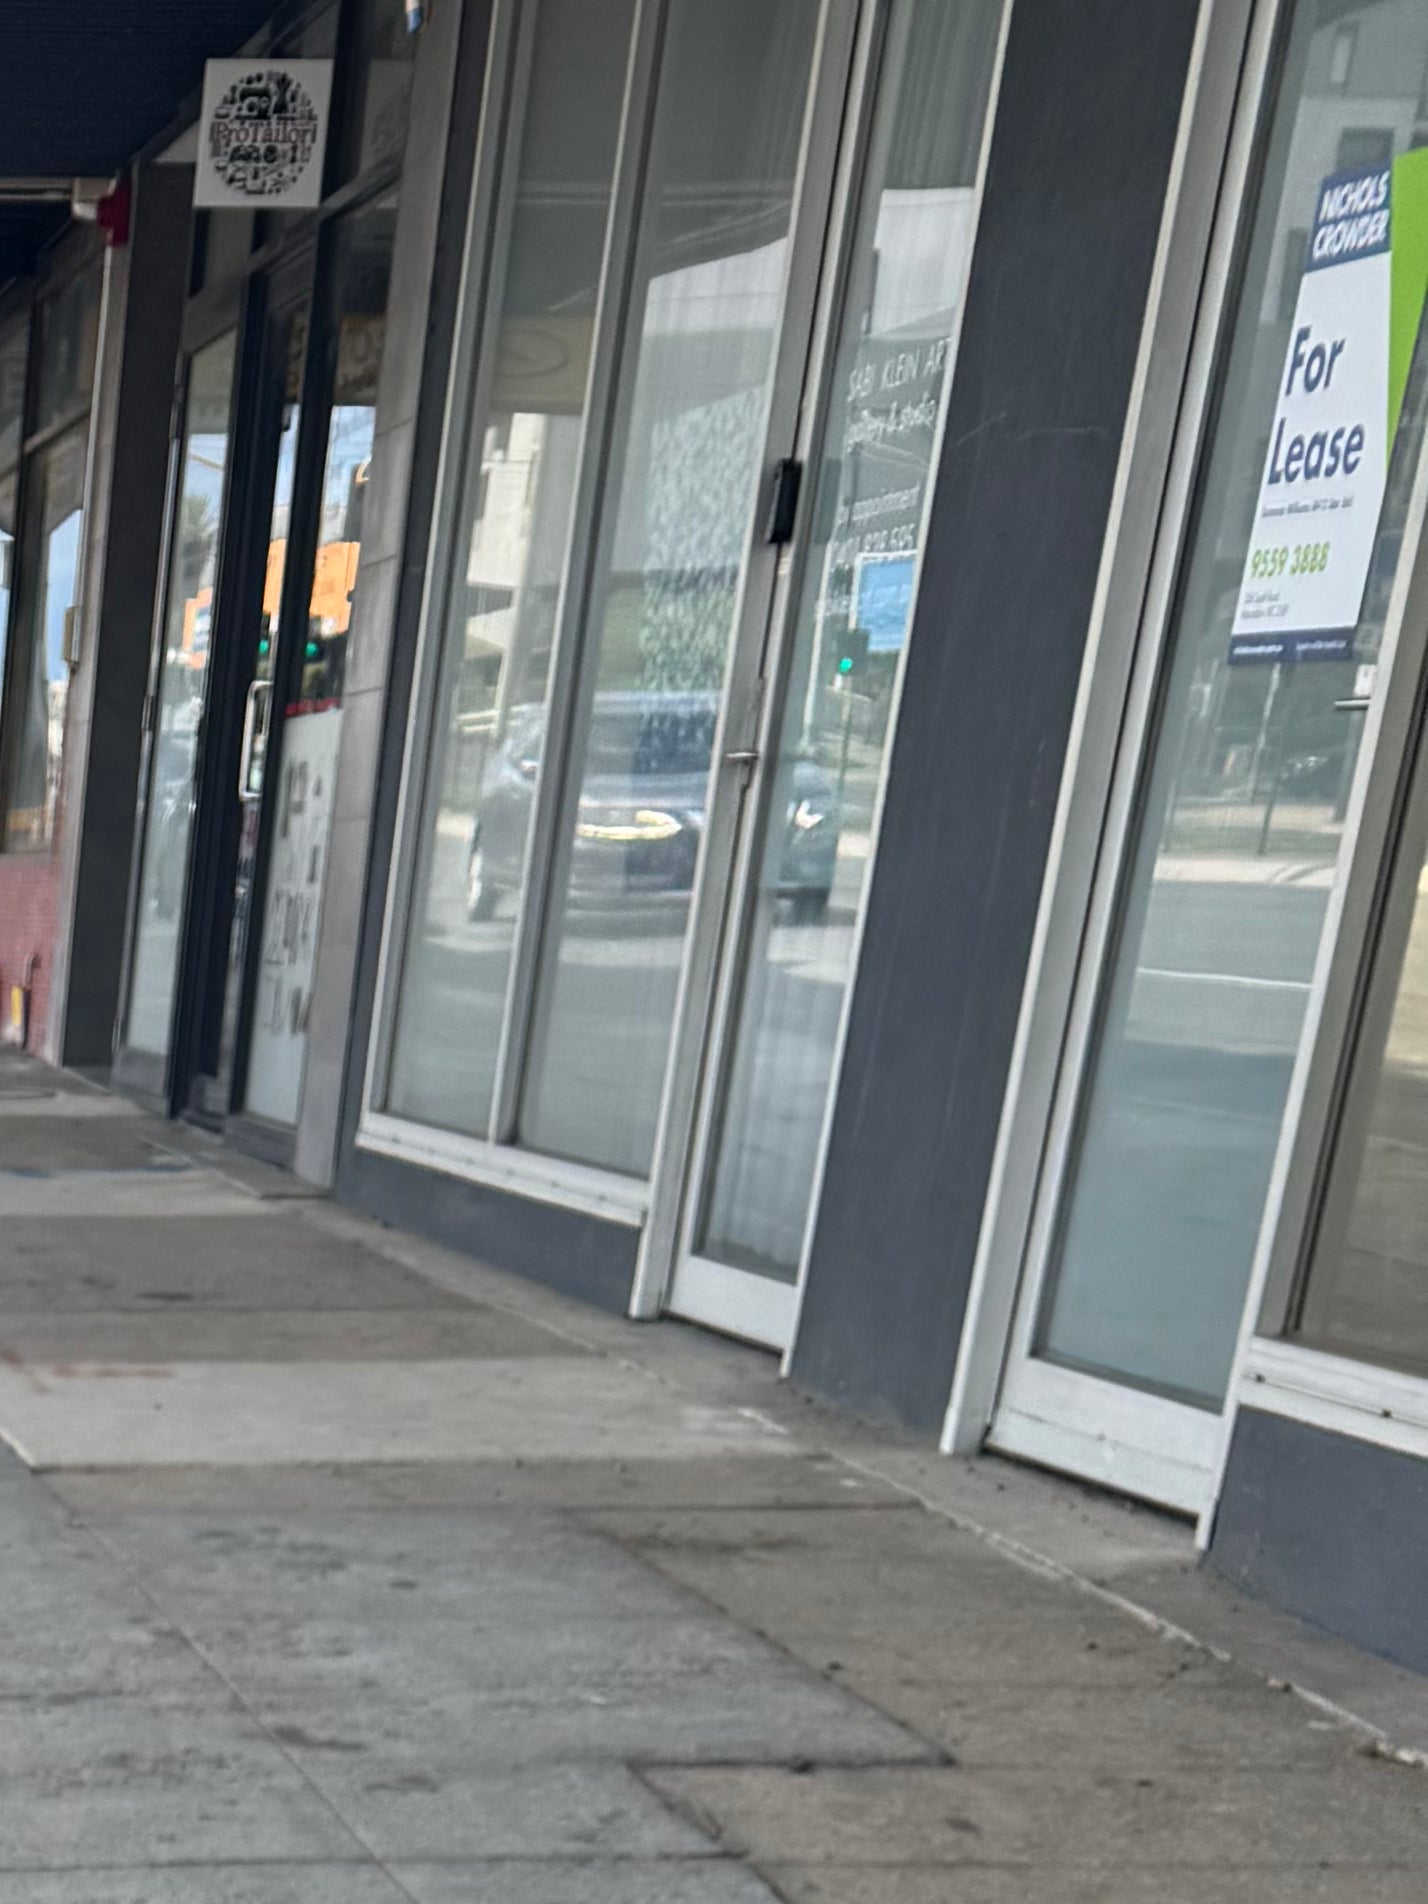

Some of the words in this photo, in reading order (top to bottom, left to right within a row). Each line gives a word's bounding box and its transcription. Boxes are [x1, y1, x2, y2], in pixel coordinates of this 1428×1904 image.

[1318, 170, 1391, 224] NICHOLS
[1311, 208, 1390, 262] CROWDER
[1285, 324, 1347, 398] For
[1267, 422, 1366, 487] Lease
[1249, 545, 1290, 580] 9559
[1288, 540, 1331, 577] 3888
